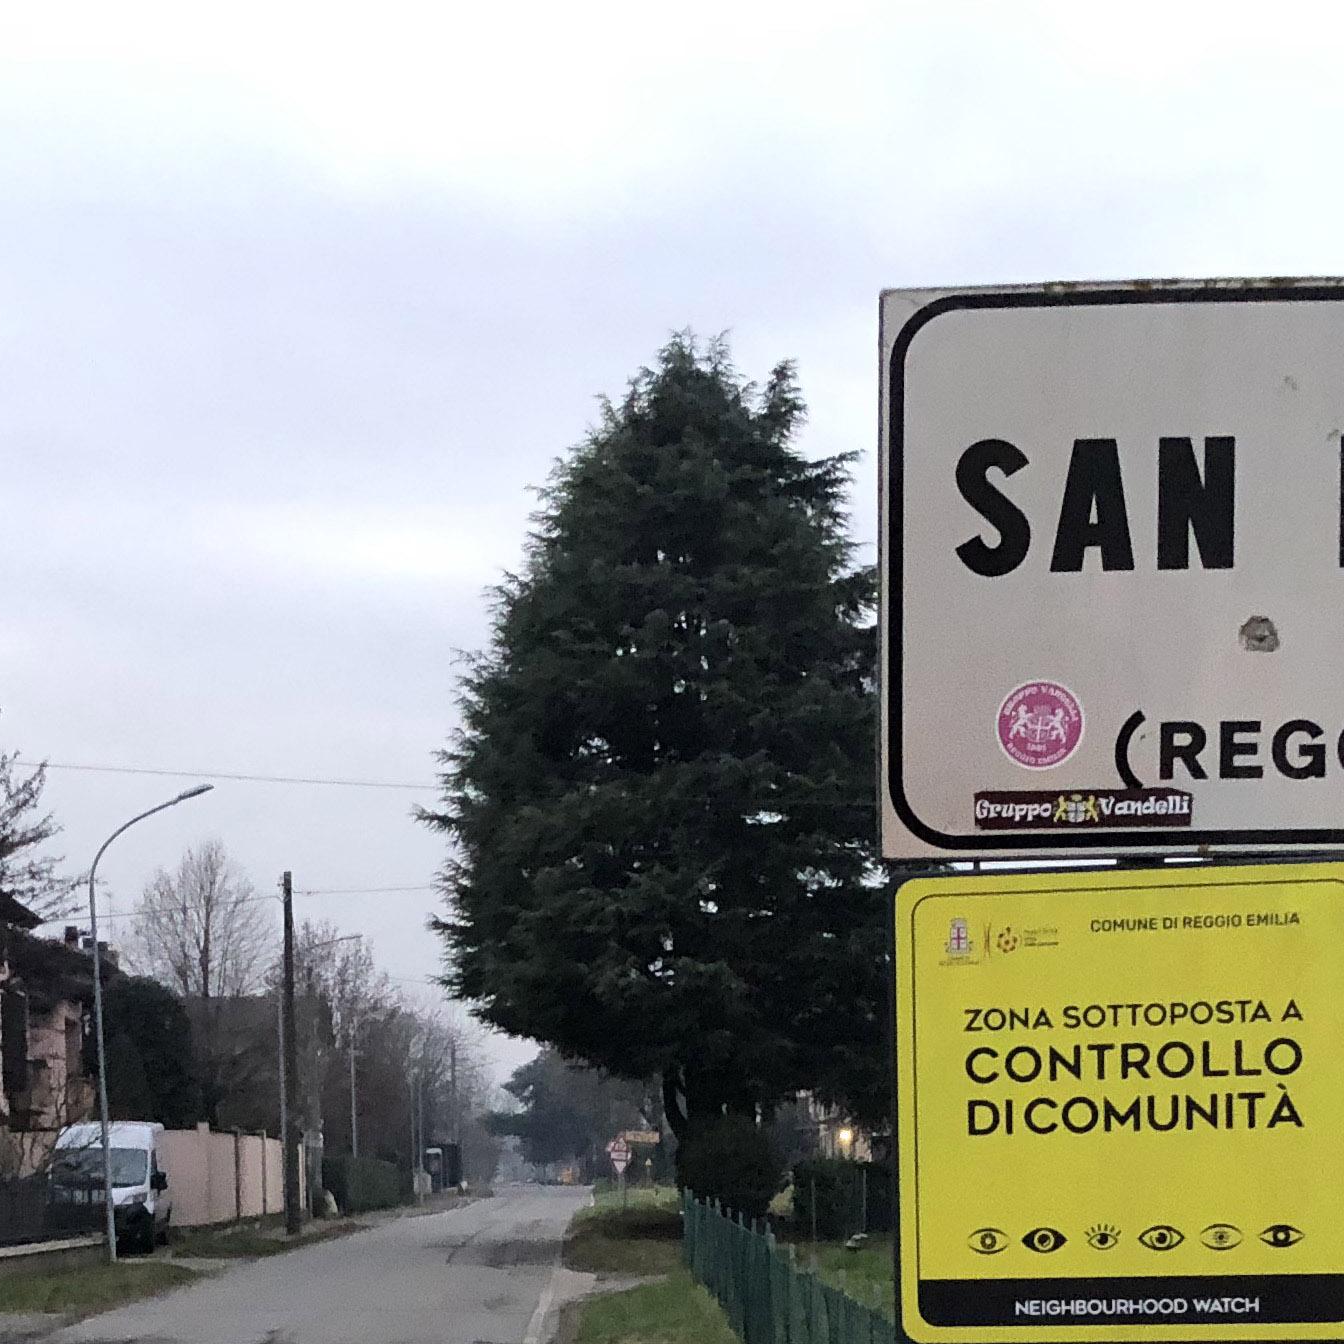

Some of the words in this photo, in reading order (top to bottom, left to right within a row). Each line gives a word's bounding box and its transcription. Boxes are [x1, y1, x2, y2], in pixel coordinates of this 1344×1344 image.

[954, 435, 1236, 578] SAN
[974, 799, 1053, 822] Gruppo
[1098, 795, 1191, 816] Vandelli
[1090, 917, 1158, 933] COMUNE
[1162, 916, 1178, 930] DI
[1182, 913, 1243, 930] REGGIO
[1246, 911, 1300, 928] EMILIA
[963, 1007, 1054, 1032] ZONA
[1062, 999, 1272, 1030] SOTTOPOSTA
[1280, 999, 1304, 1022] A
[965, 1037, 1303, 1085] CONTROLLO
[967, 1099, 1014, 1136] DI
[1023, 1083, 1305, 1135] COMUNITÀ
[1014, 1298, 1189, 1317] NEIGHBOURHOOD
[1192, 1296, 1260, 1314] WATCH
